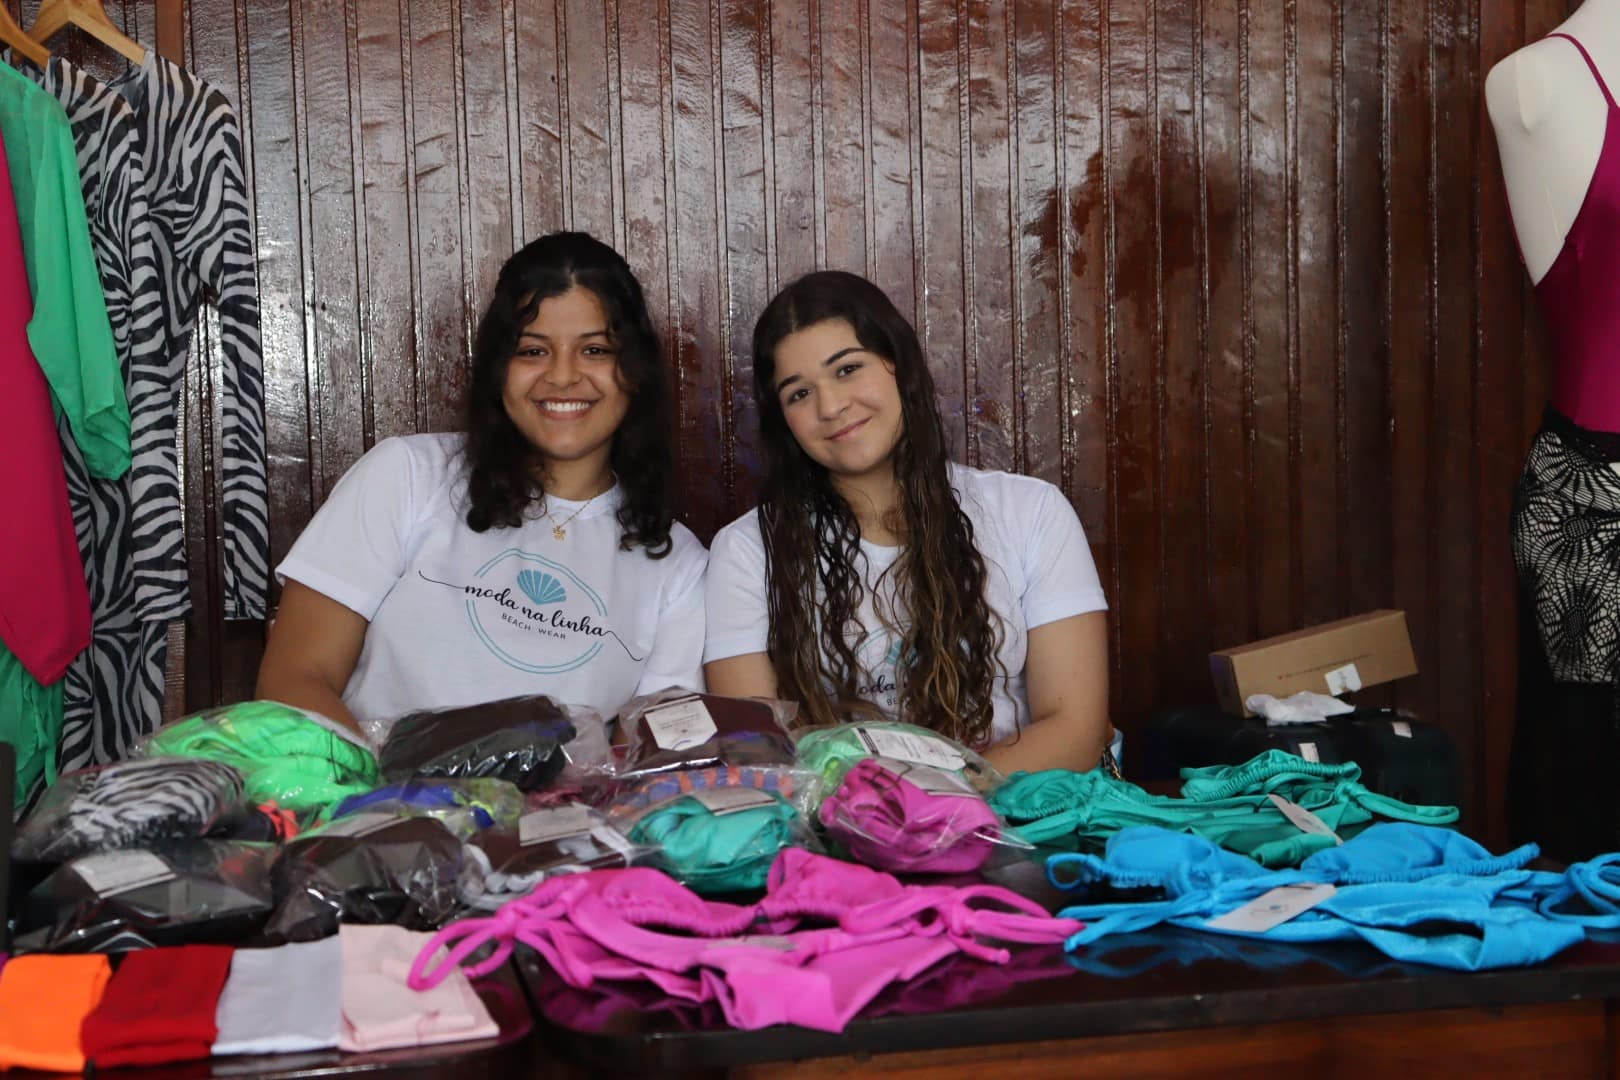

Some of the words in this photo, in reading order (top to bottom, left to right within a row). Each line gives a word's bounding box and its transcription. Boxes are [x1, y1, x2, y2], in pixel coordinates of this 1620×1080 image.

[465, 585, 519, 610] moda
[521, 606, 548, 623] na
[551, 610, 605, 637] linha
[501, 612, 531, 631] BEACH
[538, 628, 567, 640] WEAR
[858, 674, 896, 694] oda
